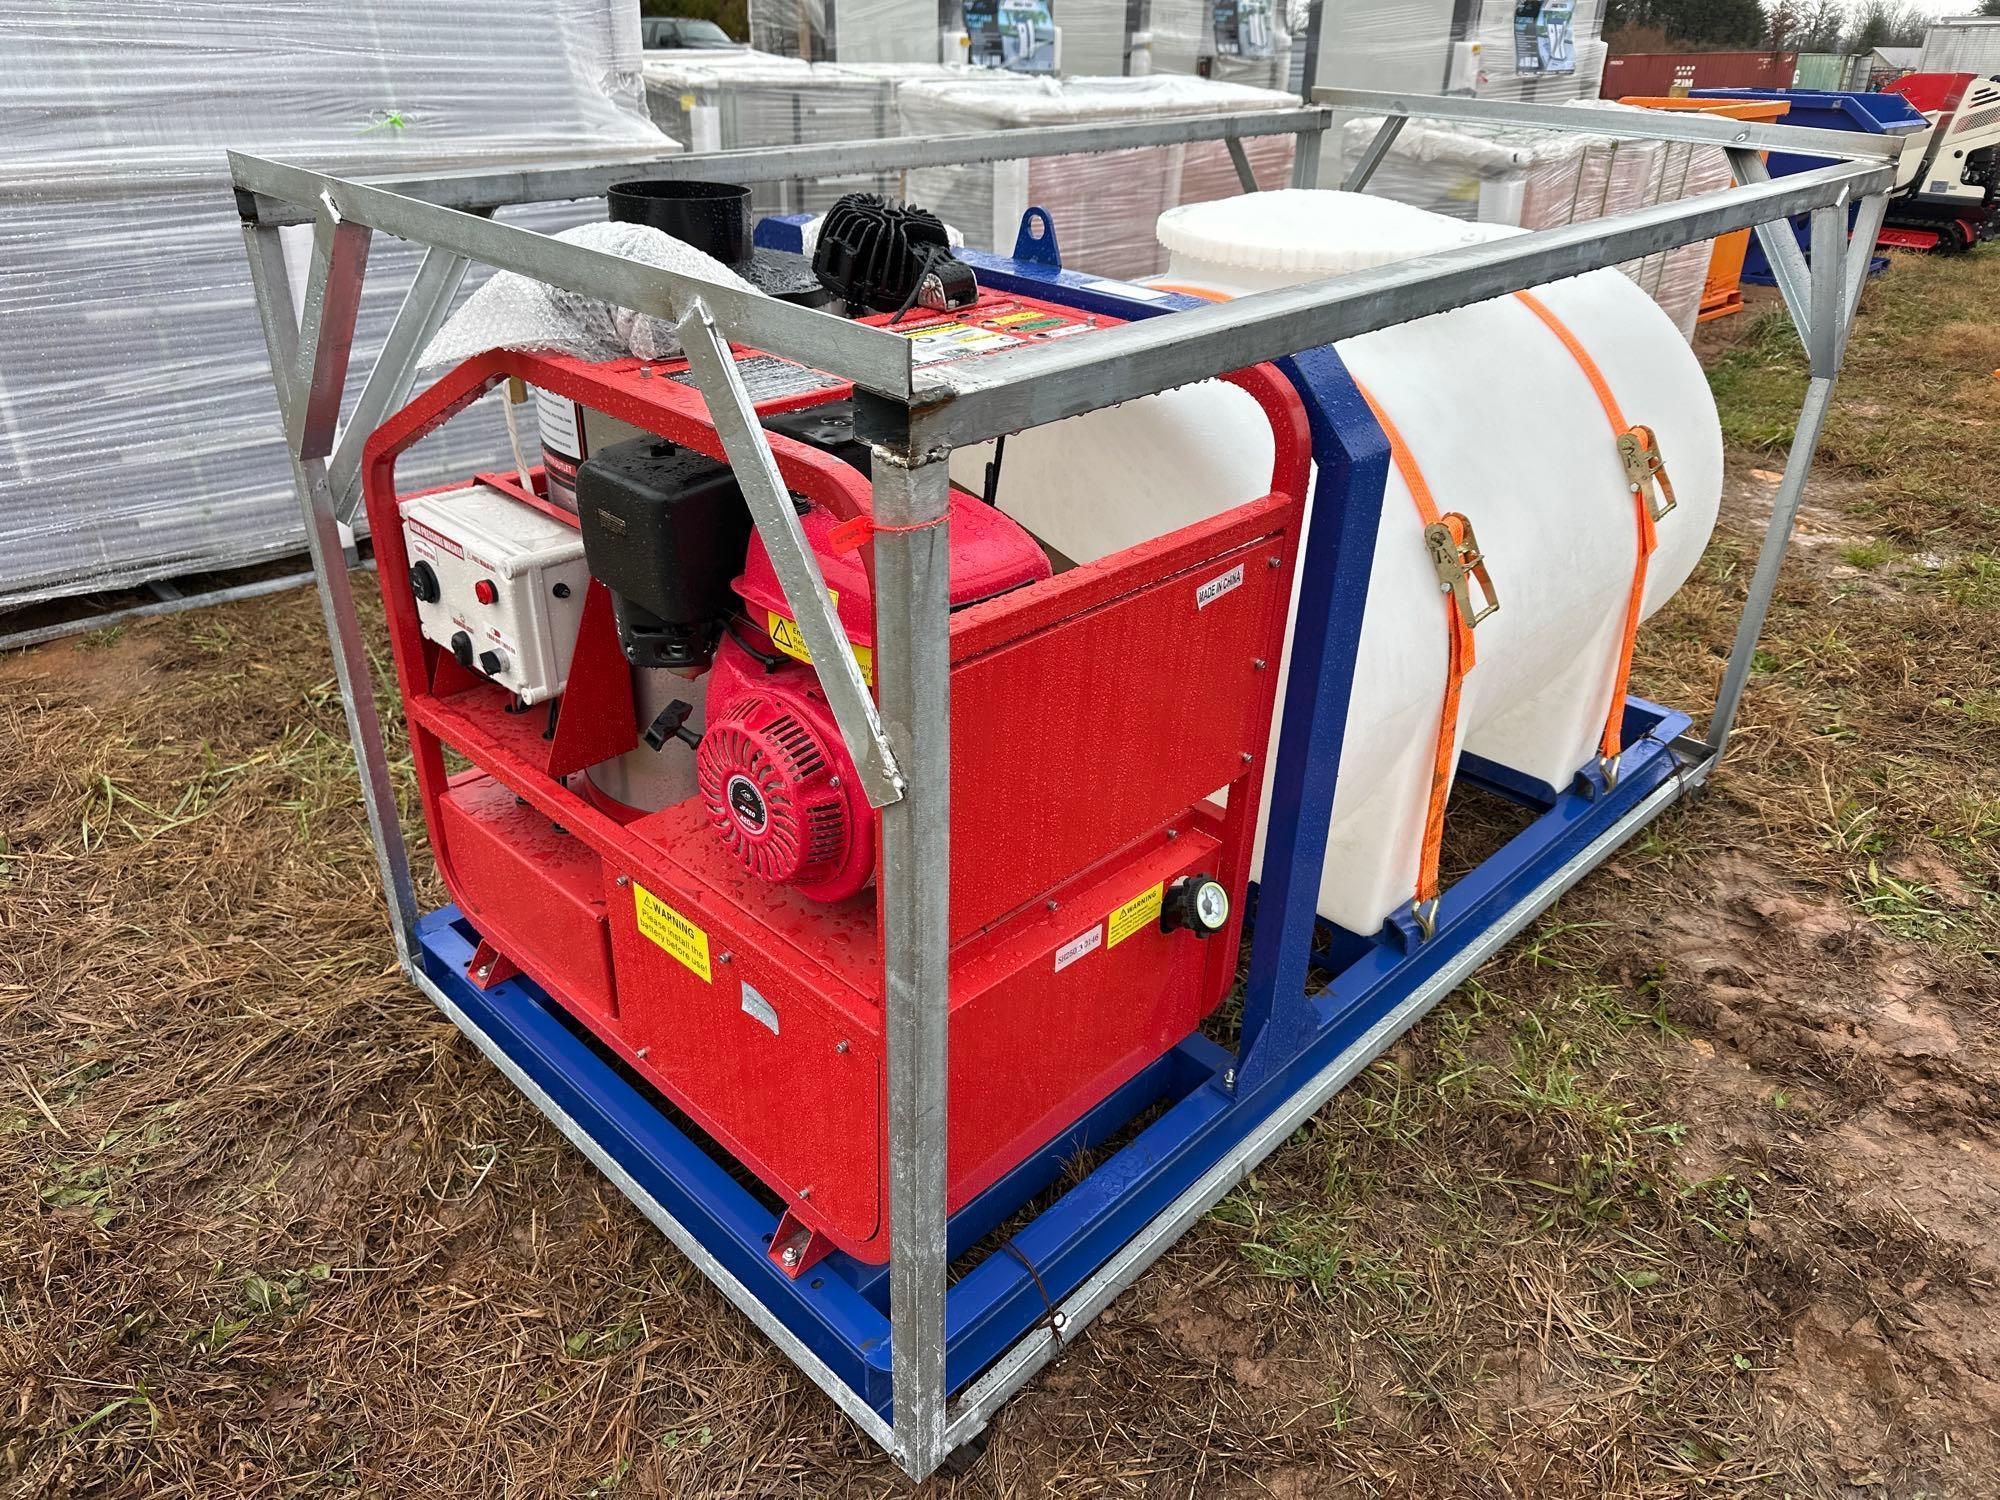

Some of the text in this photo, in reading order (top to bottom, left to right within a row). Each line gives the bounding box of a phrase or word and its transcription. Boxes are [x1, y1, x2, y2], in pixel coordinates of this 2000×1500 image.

[1673, 79, 1694, 87] ZIM
[1199, 570, 1240, 603] MADE IN CHINA
[1126, 890, 1157, 914] WARNING
[641, 907, 667, 933] Please
[667, 926, 690, 950] install
[652, 901, 695, 940] WARNING
[639, 916, 708, 974] battery before use!
